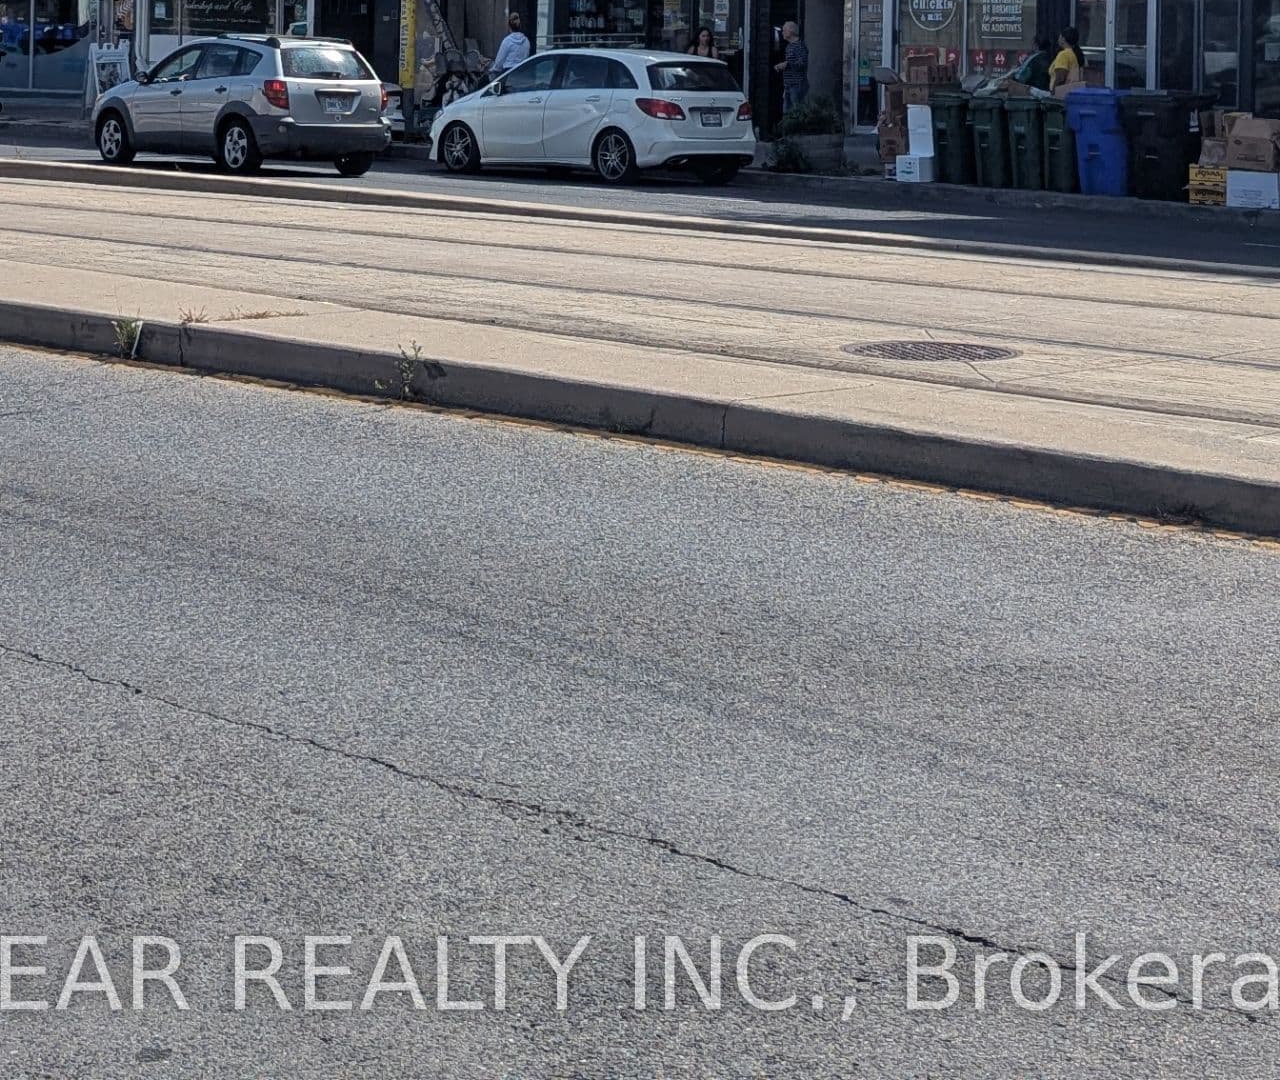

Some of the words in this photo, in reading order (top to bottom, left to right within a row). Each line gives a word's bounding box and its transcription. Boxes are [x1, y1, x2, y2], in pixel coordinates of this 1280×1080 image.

[912, 0, 953, 10] CHICKEN
[981, 24, 990, 32] NO
[990, 24, 1022, 32] ADDITIVES
